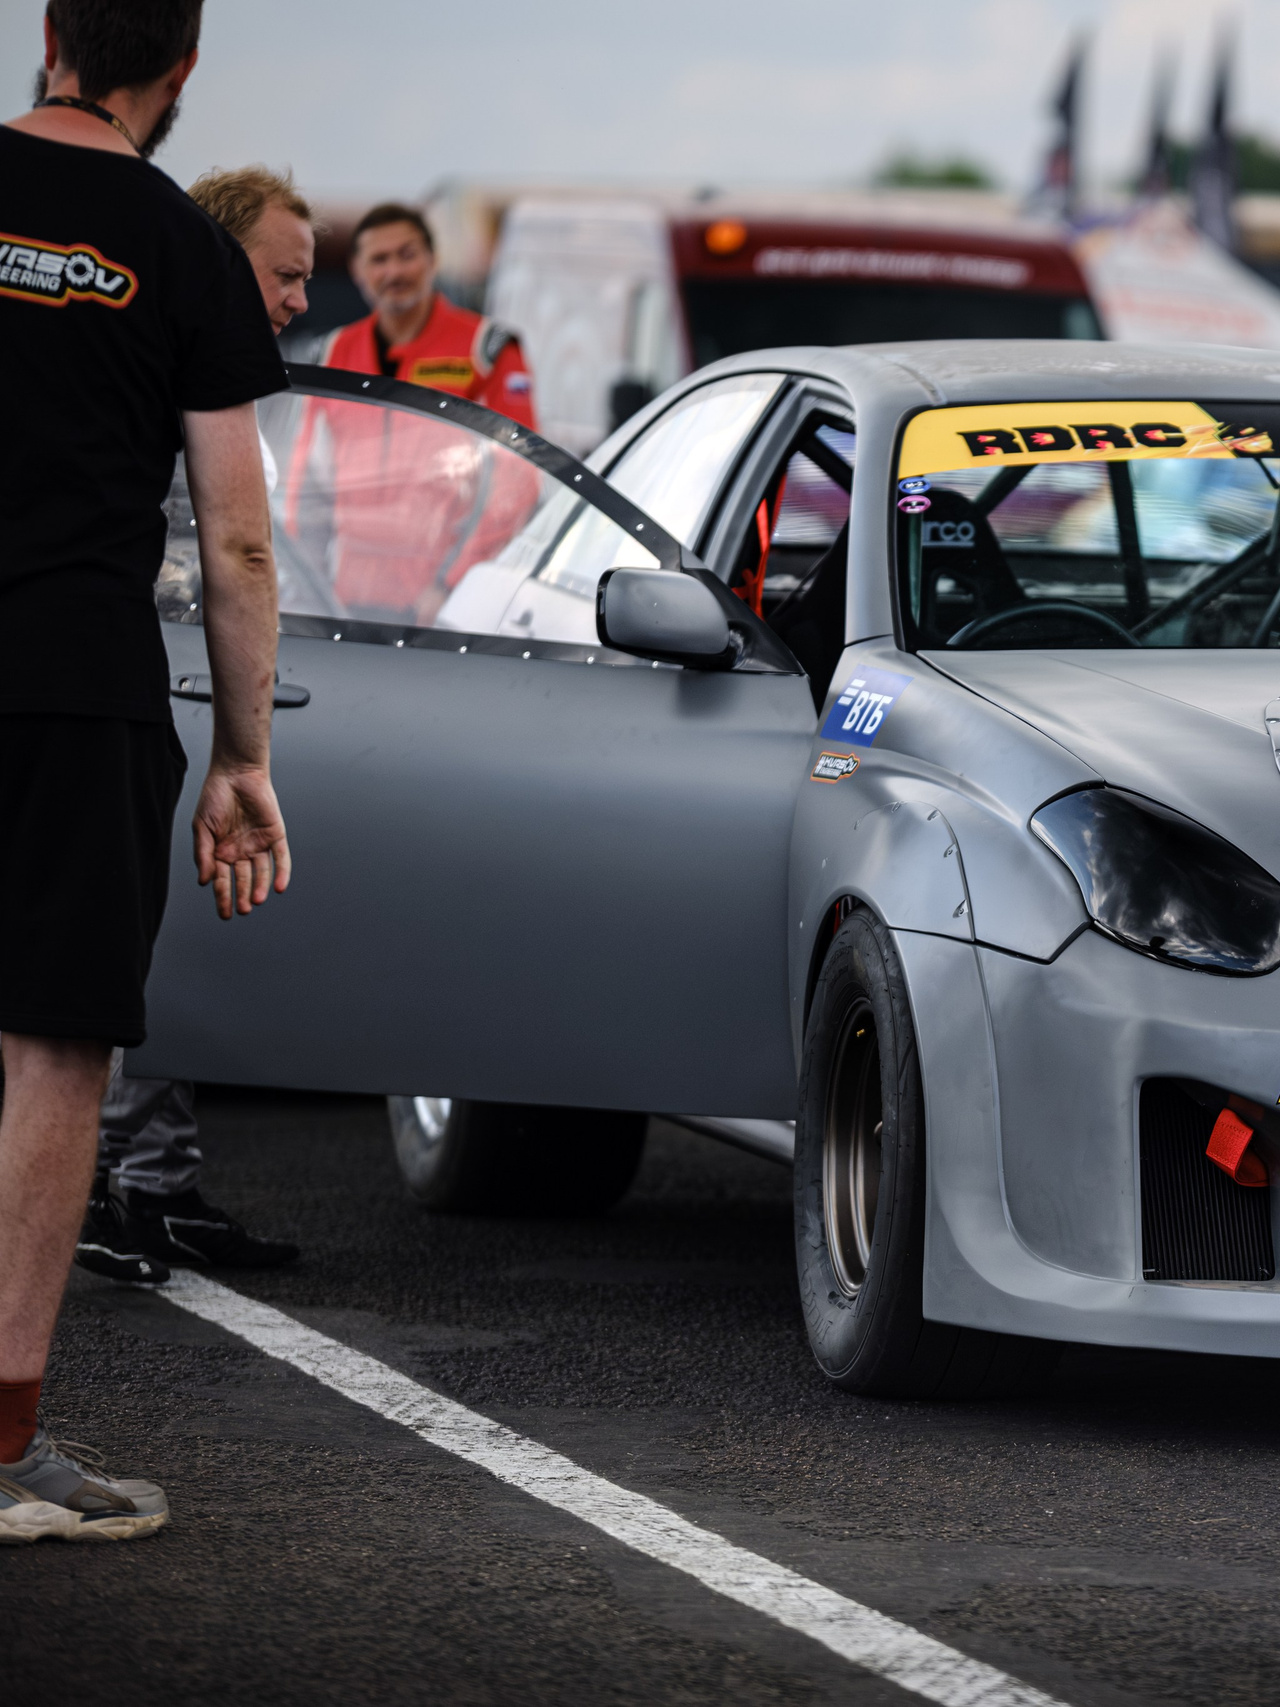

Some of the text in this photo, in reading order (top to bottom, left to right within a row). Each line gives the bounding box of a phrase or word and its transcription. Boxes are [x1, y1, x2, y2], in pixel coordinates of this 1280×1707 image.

[0, 264, 61, 292] EERING
[956, 422, 1188, 457] RDRC
[842, 690, 893, 735] ВТБ
